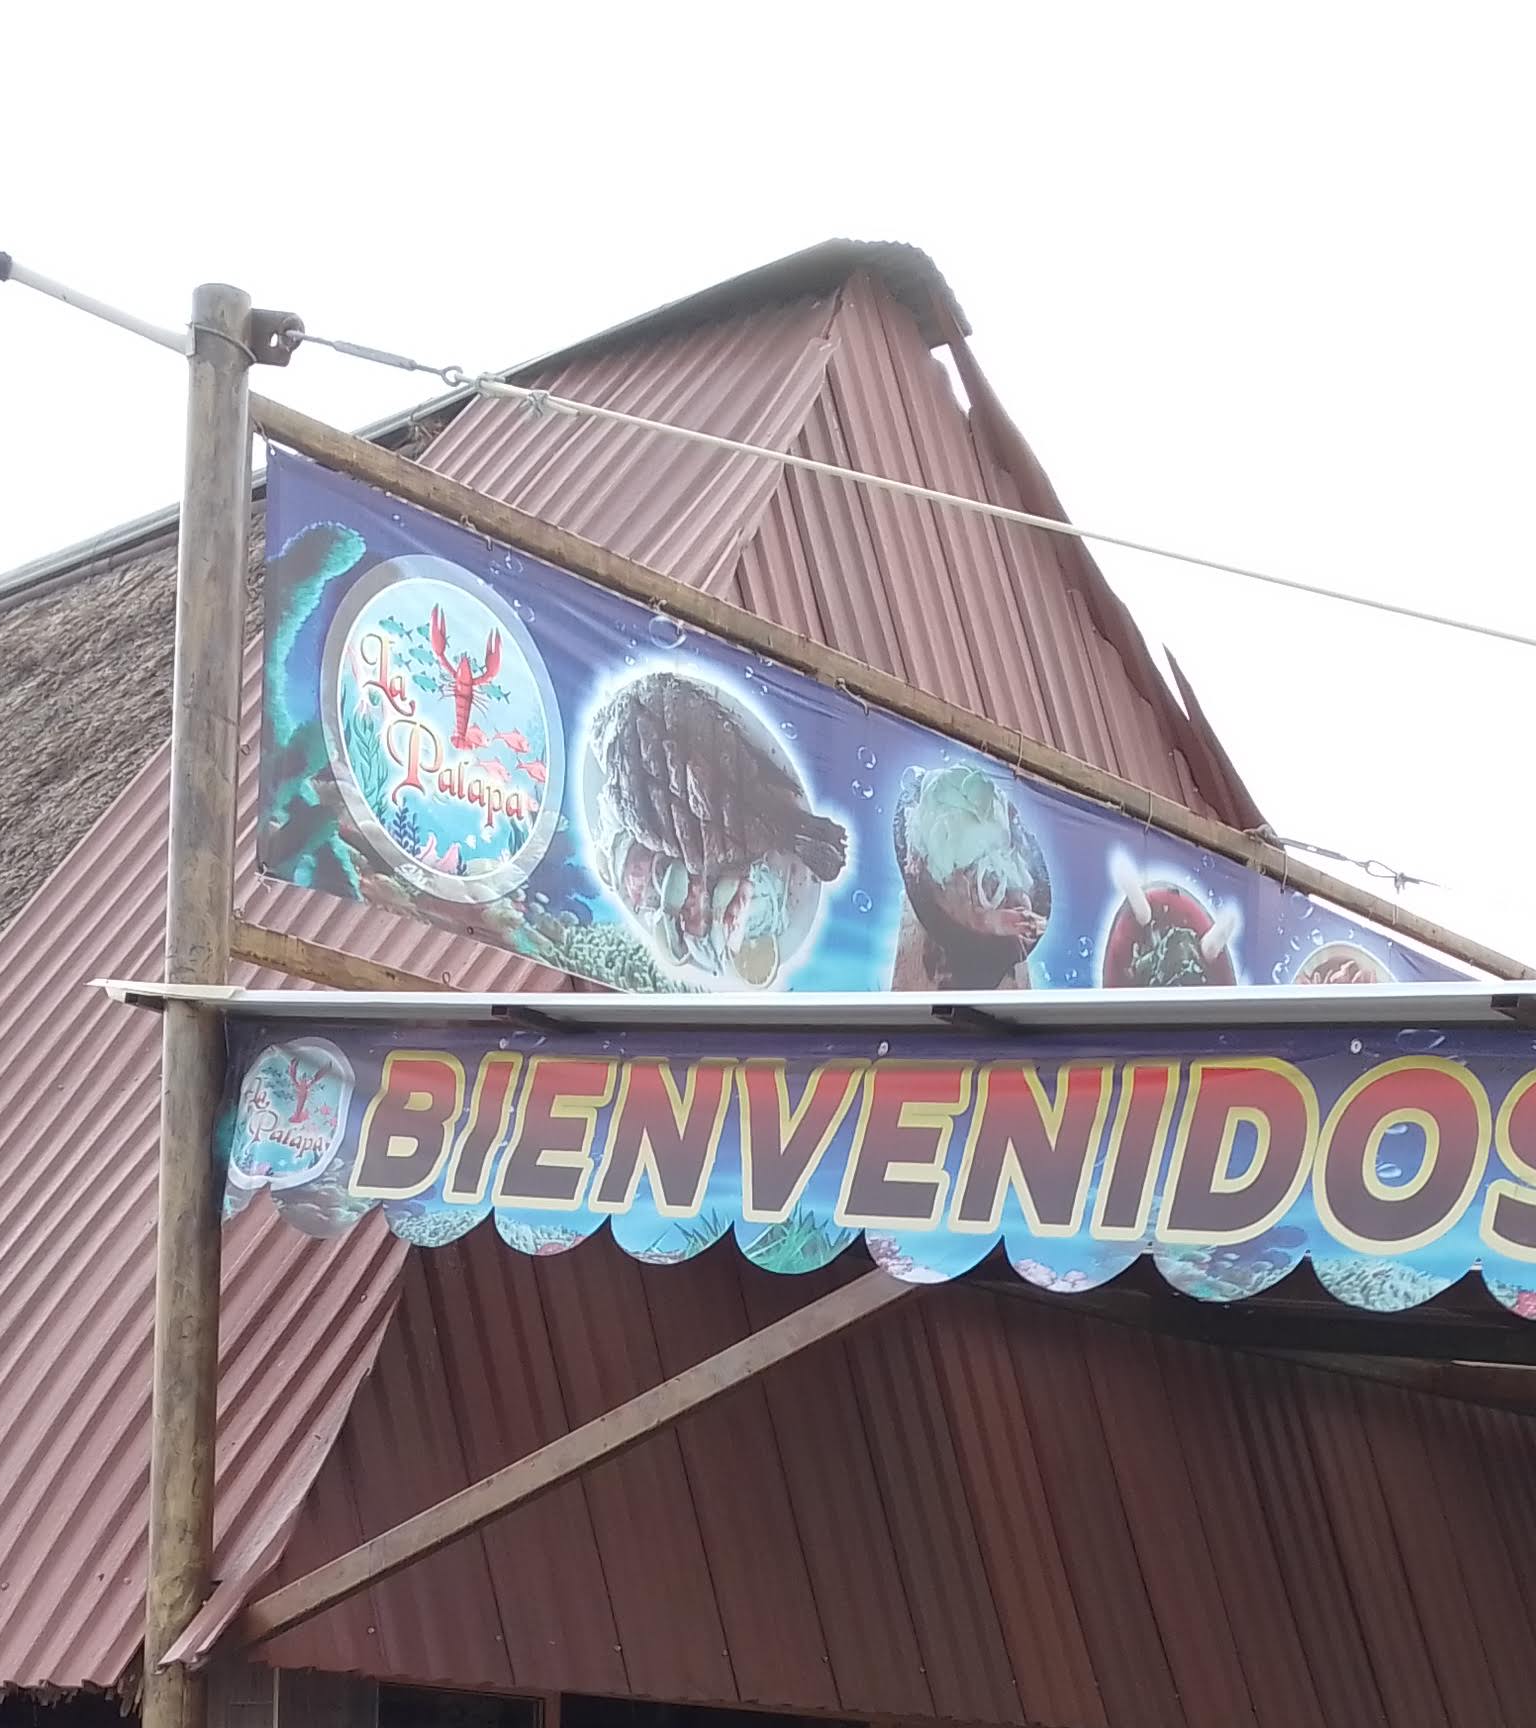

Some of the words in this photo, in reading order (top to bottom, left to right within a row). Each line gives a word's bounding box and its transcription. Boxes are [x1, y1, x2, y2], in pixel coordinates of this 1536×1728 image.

[360, 632, 417, 718] La
[386, 718, 525, 829] Palapa
[244, 1109, 323, 1158] Palapa
